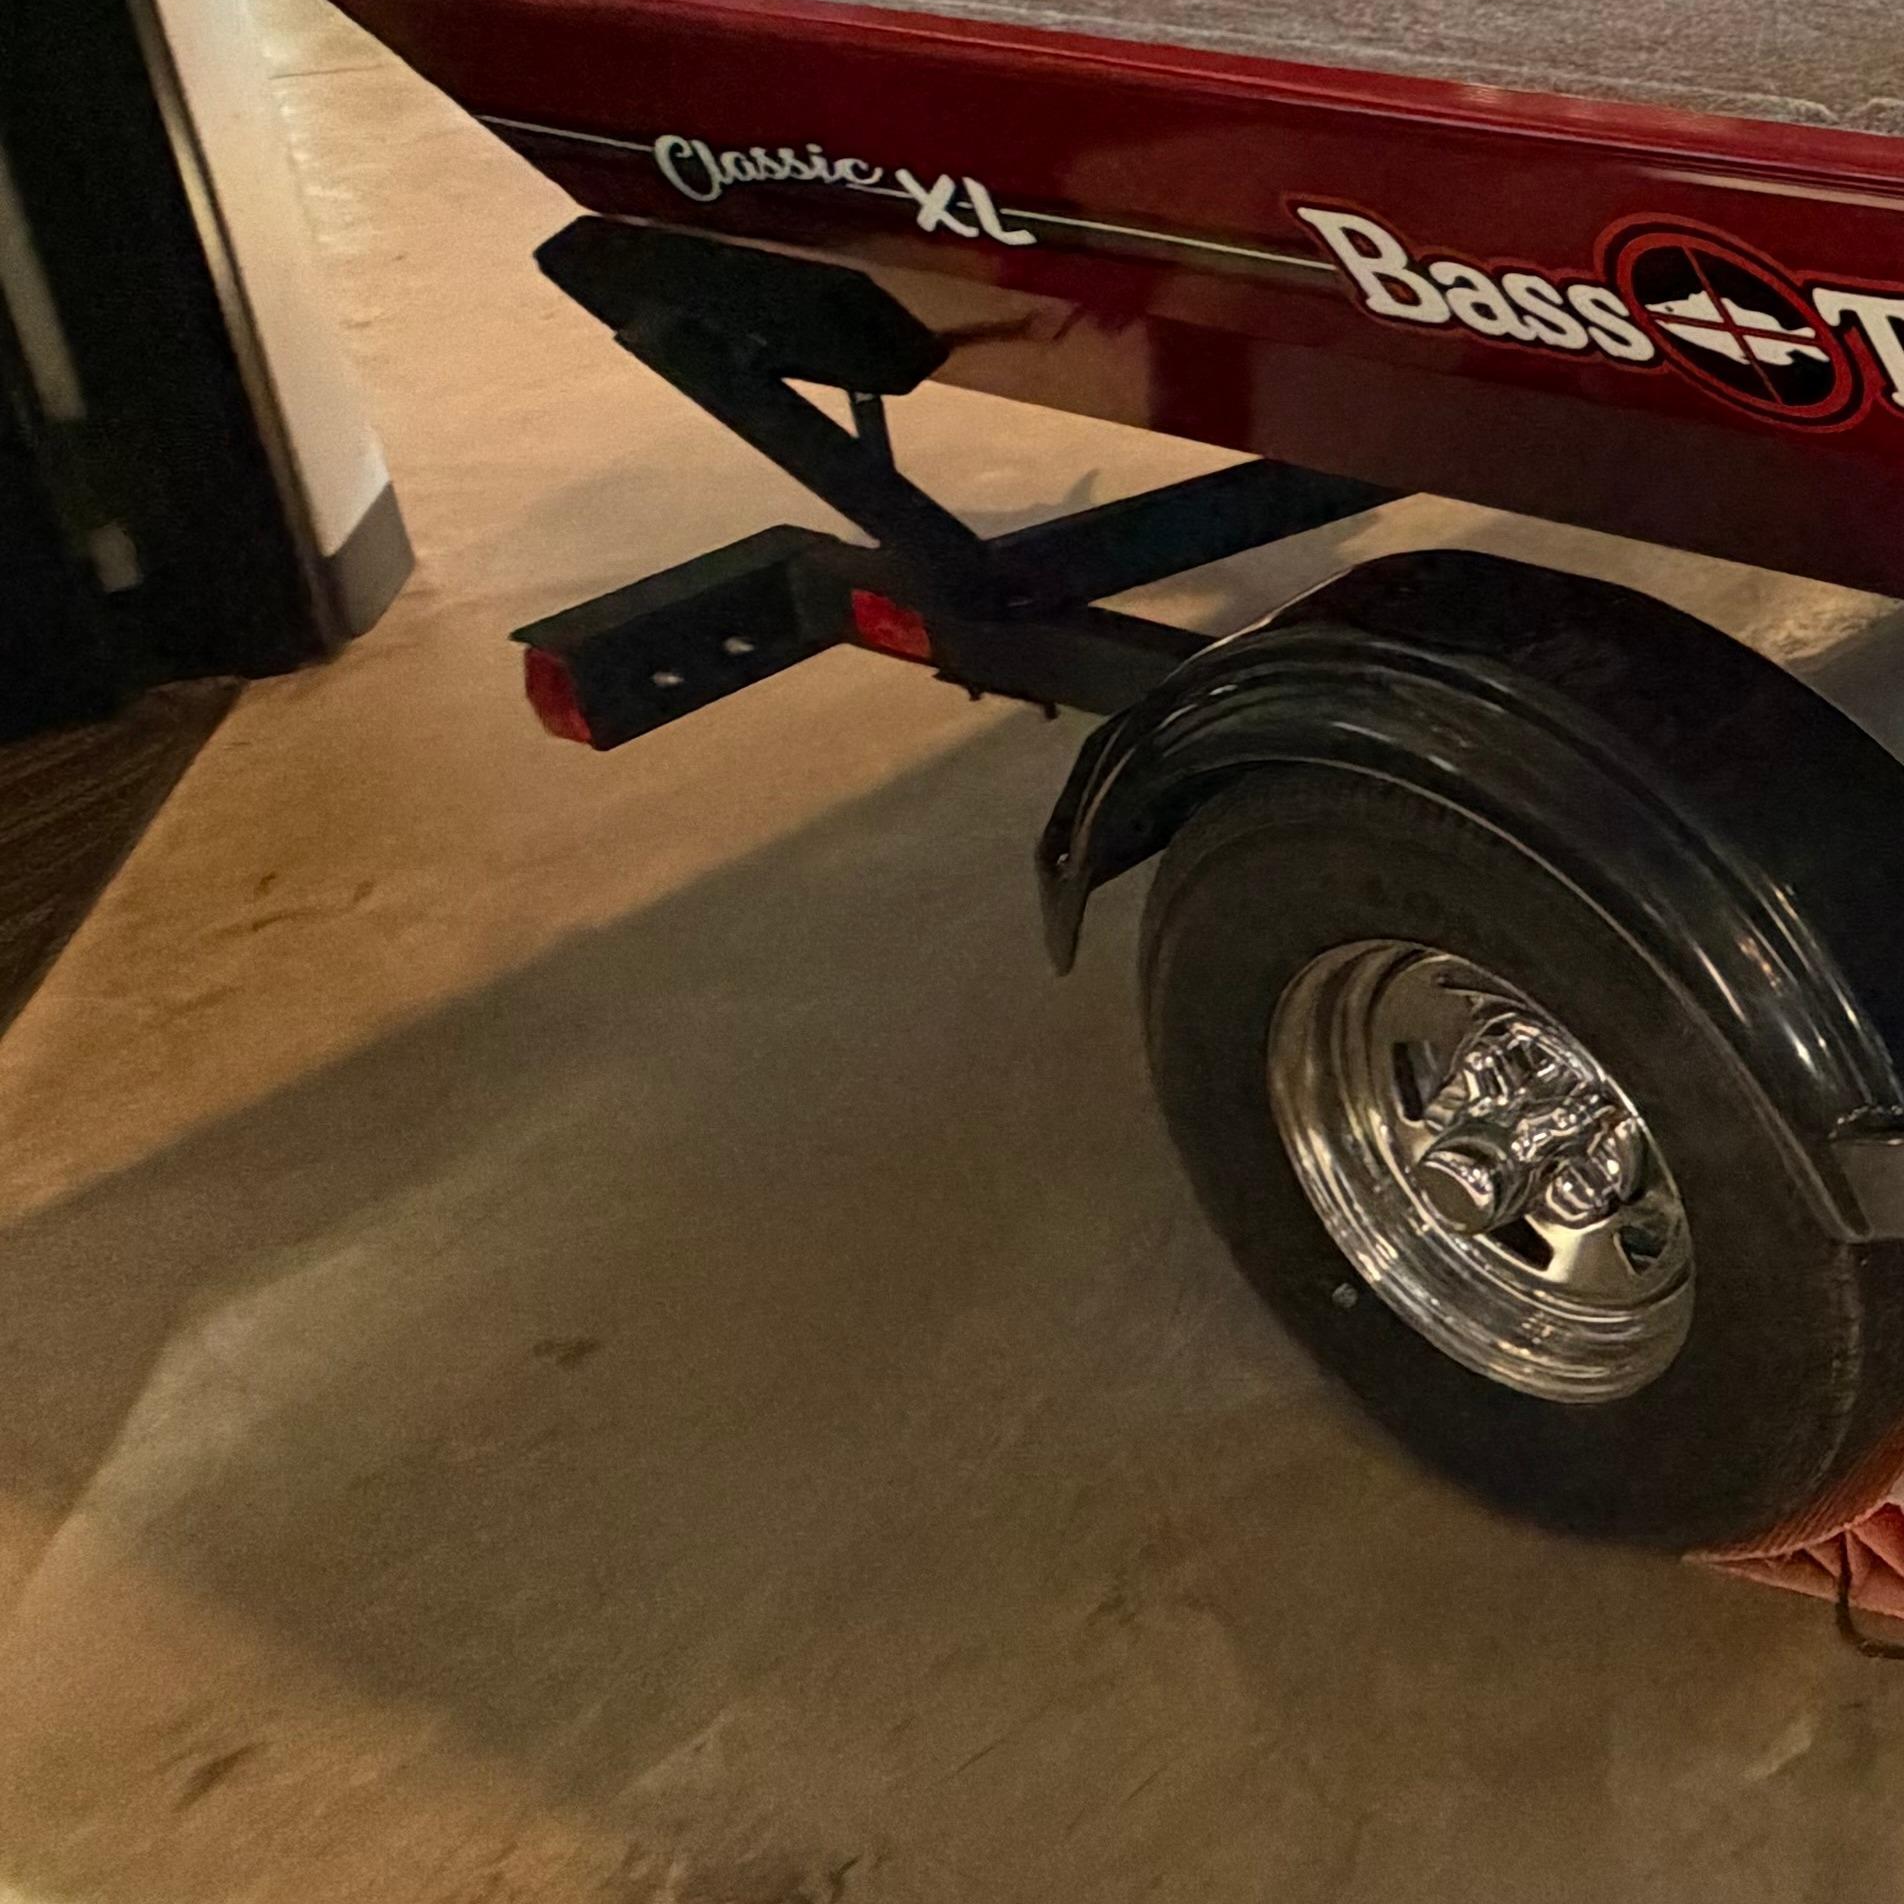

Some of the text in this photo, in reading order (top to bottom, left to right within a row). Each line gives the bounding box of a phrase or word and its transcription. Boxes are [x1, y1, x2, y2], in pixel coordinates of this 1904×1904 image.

[654, 134, 1037, 246] Classic XL
[1297, 206, 1656, 362] Bass
